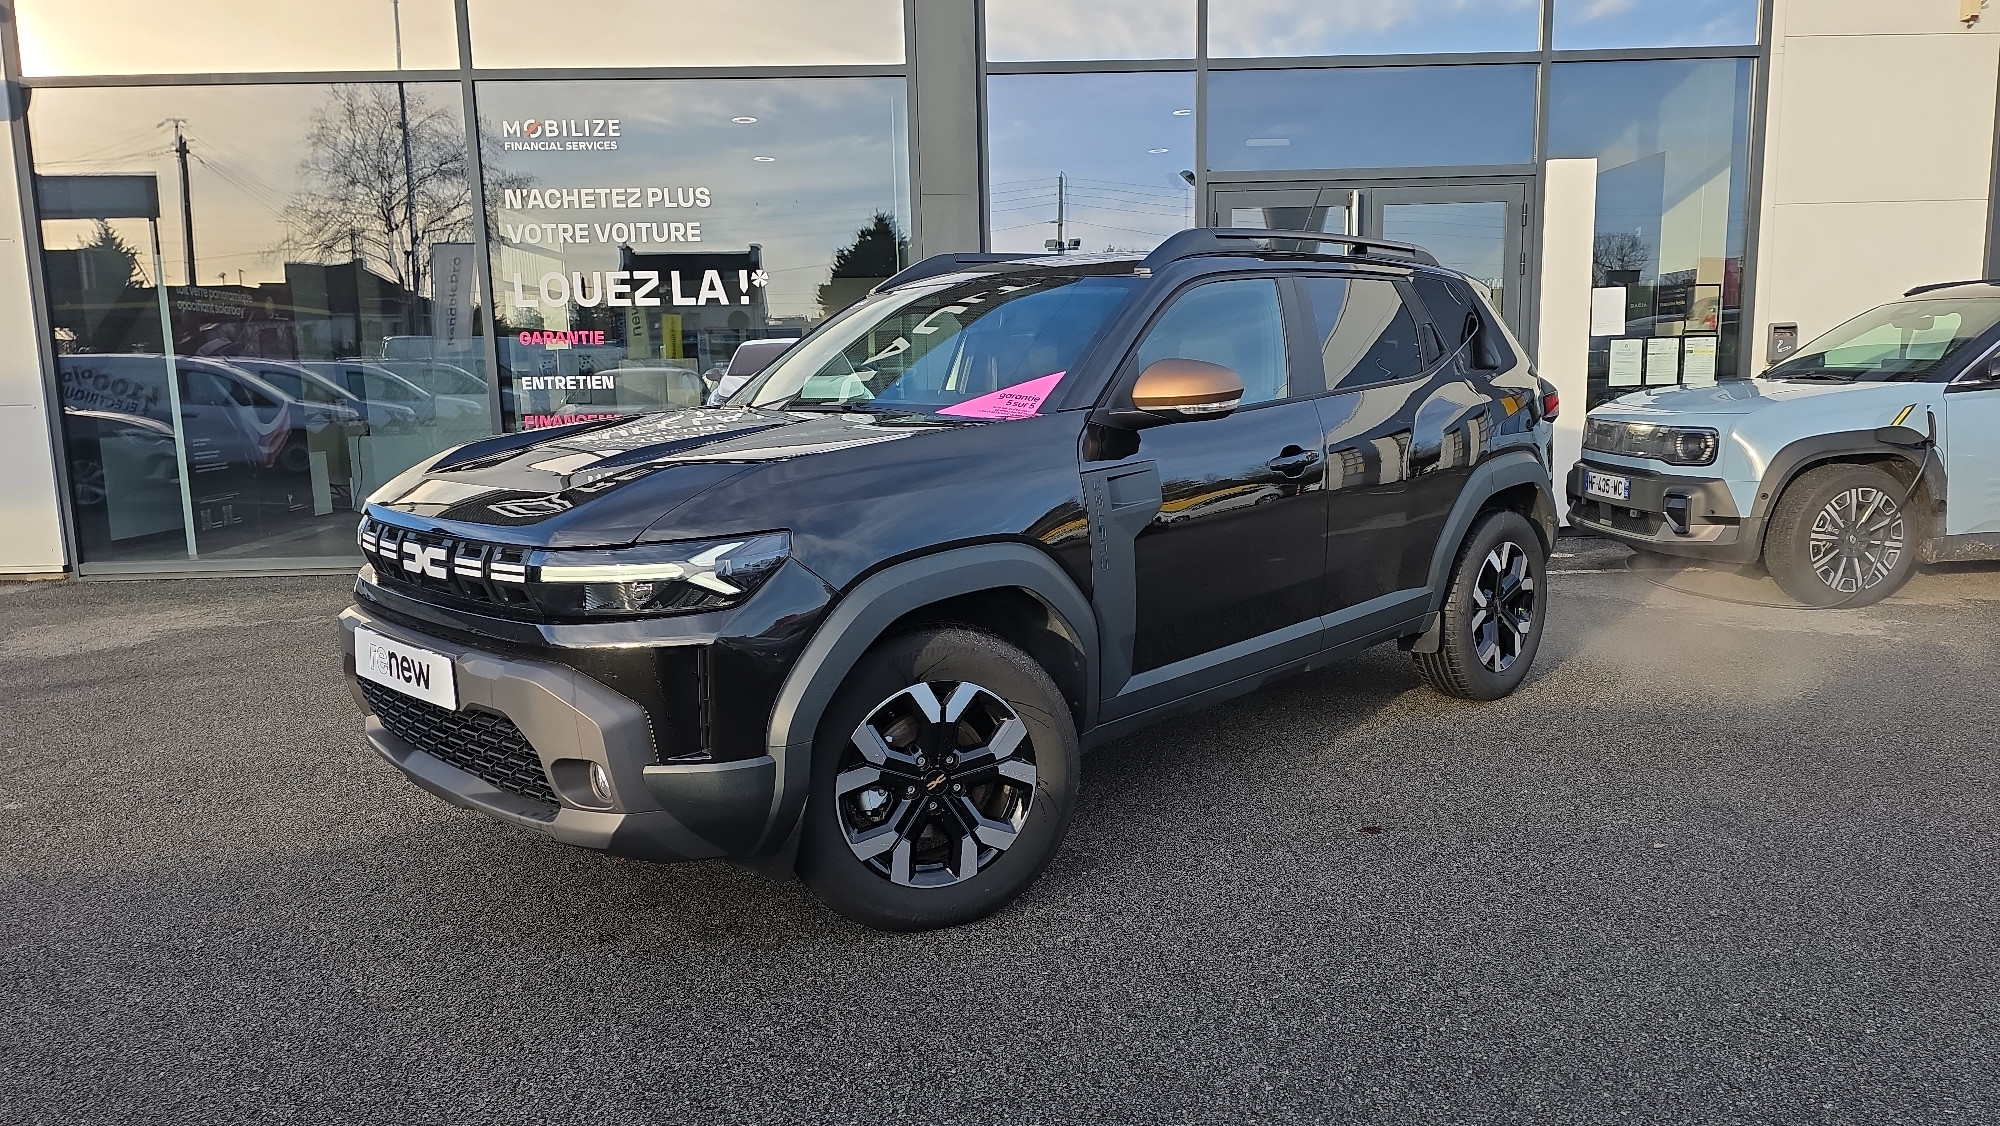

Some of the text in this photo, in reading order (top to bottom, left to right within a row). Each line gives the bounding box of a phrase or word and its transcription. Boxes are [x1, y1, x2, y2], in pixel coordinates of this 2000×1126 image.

[502, 119, 621, 138] MOBILIZE
[504, 140, 618, 151] FINANCIAL SERVICES
[504, 187, 711, 209] N'ACHETEZ PLUS
[506, 222, 701, 244] VOTRE VOITURE
[513, 270, 661, 307] LOUEZ
[670, 269, 730, 306] LA
[519, 331, 605, 345] GARANTIE
[522, 376, 614, 390] ENTRETIEN
[998, 392, 1041, 403] garantie
[1028, 402, 1037, 410] 5
